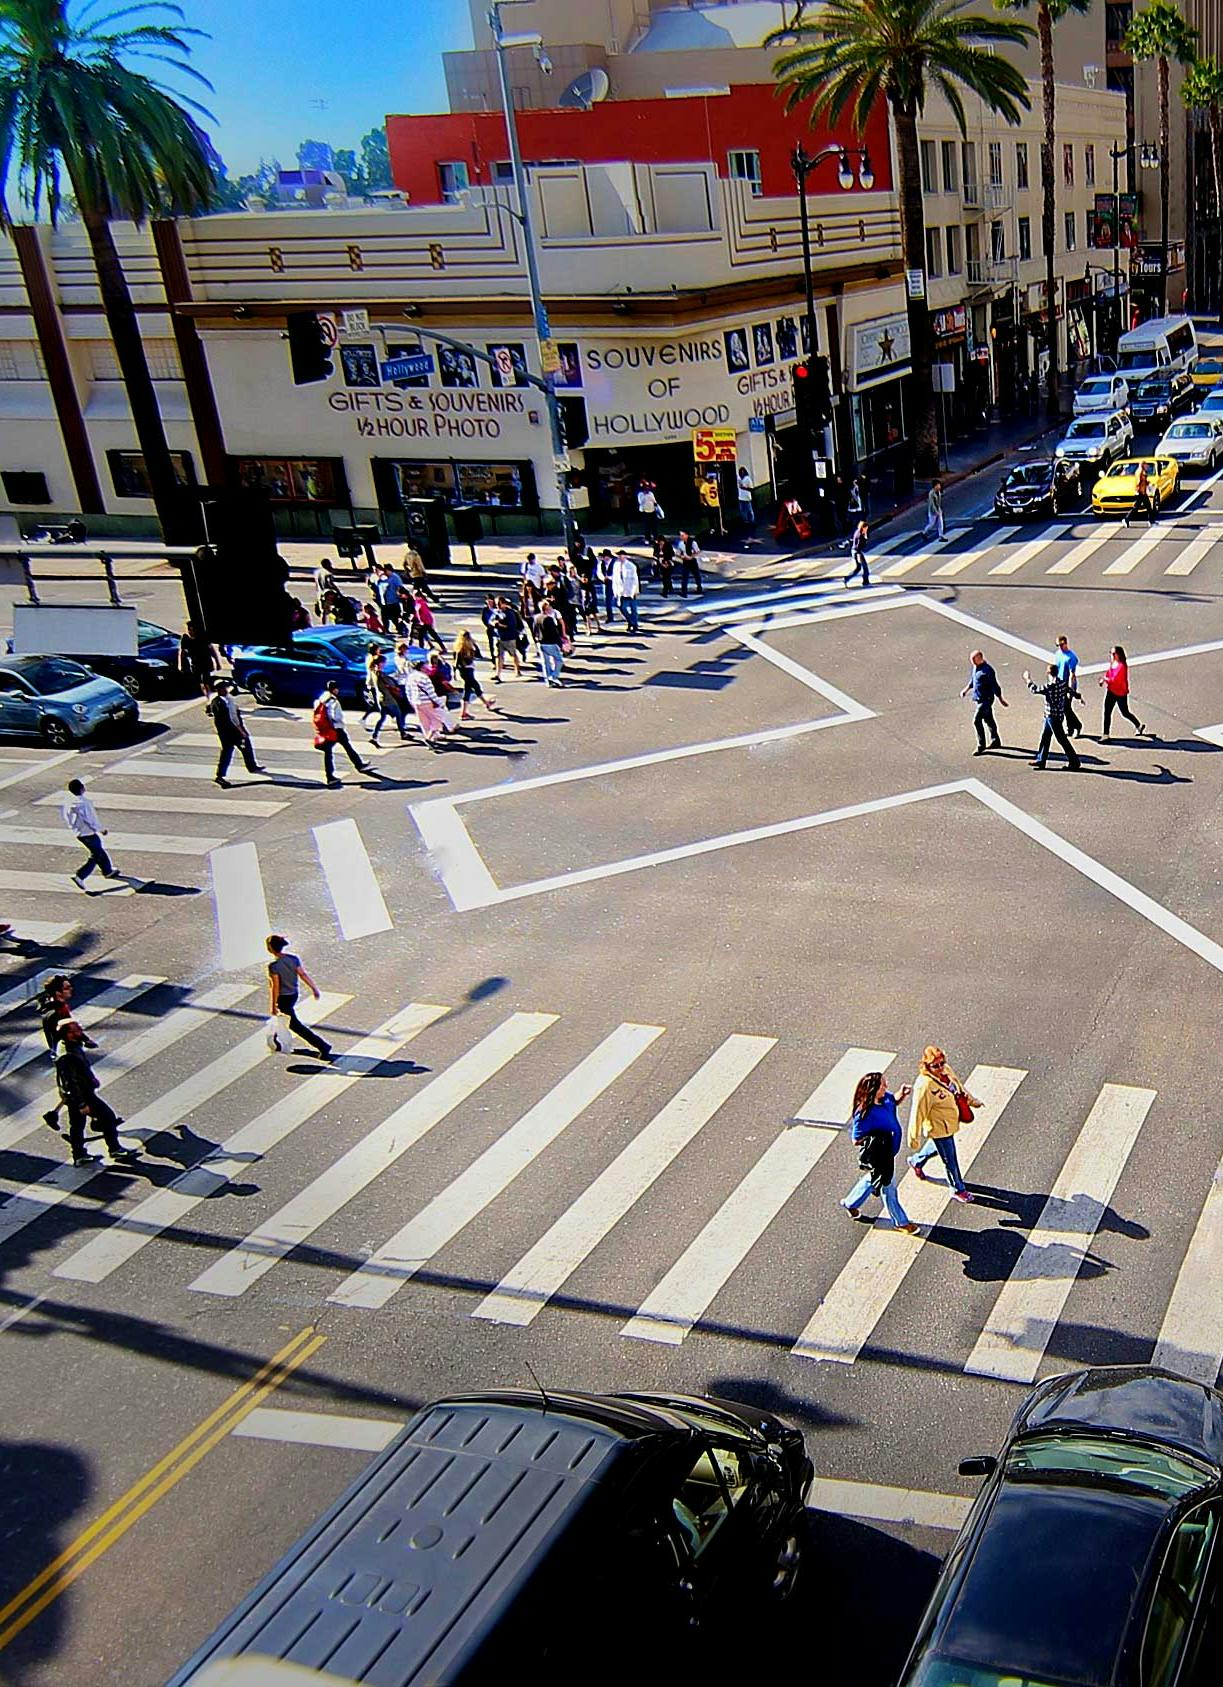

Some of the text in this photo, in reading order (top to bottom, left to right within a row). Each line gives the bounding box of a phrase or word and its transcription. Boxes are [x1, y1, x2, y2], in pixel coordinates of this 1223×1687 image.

[1140, 262, 1161, 273] Tours
[586, 340, 722, 370] SOUVENIRS
[386, 360, 429, 377] Hollywood
[648, 378, 680, 399] OF
[737, 368, 778, 395] GIFTS
[779, 370, 786, 383] &
[328, 391, 525, 413] GIFTS & SOUVENIRS
[764, 391, 790, 414] HOUR
[376, 418, 429, 437] HOUR
[434, 413, 501, 438] PHOTO
[594, 404, 730, 435] HOLLYWOOD
[696, 431, 716, 460] 5
